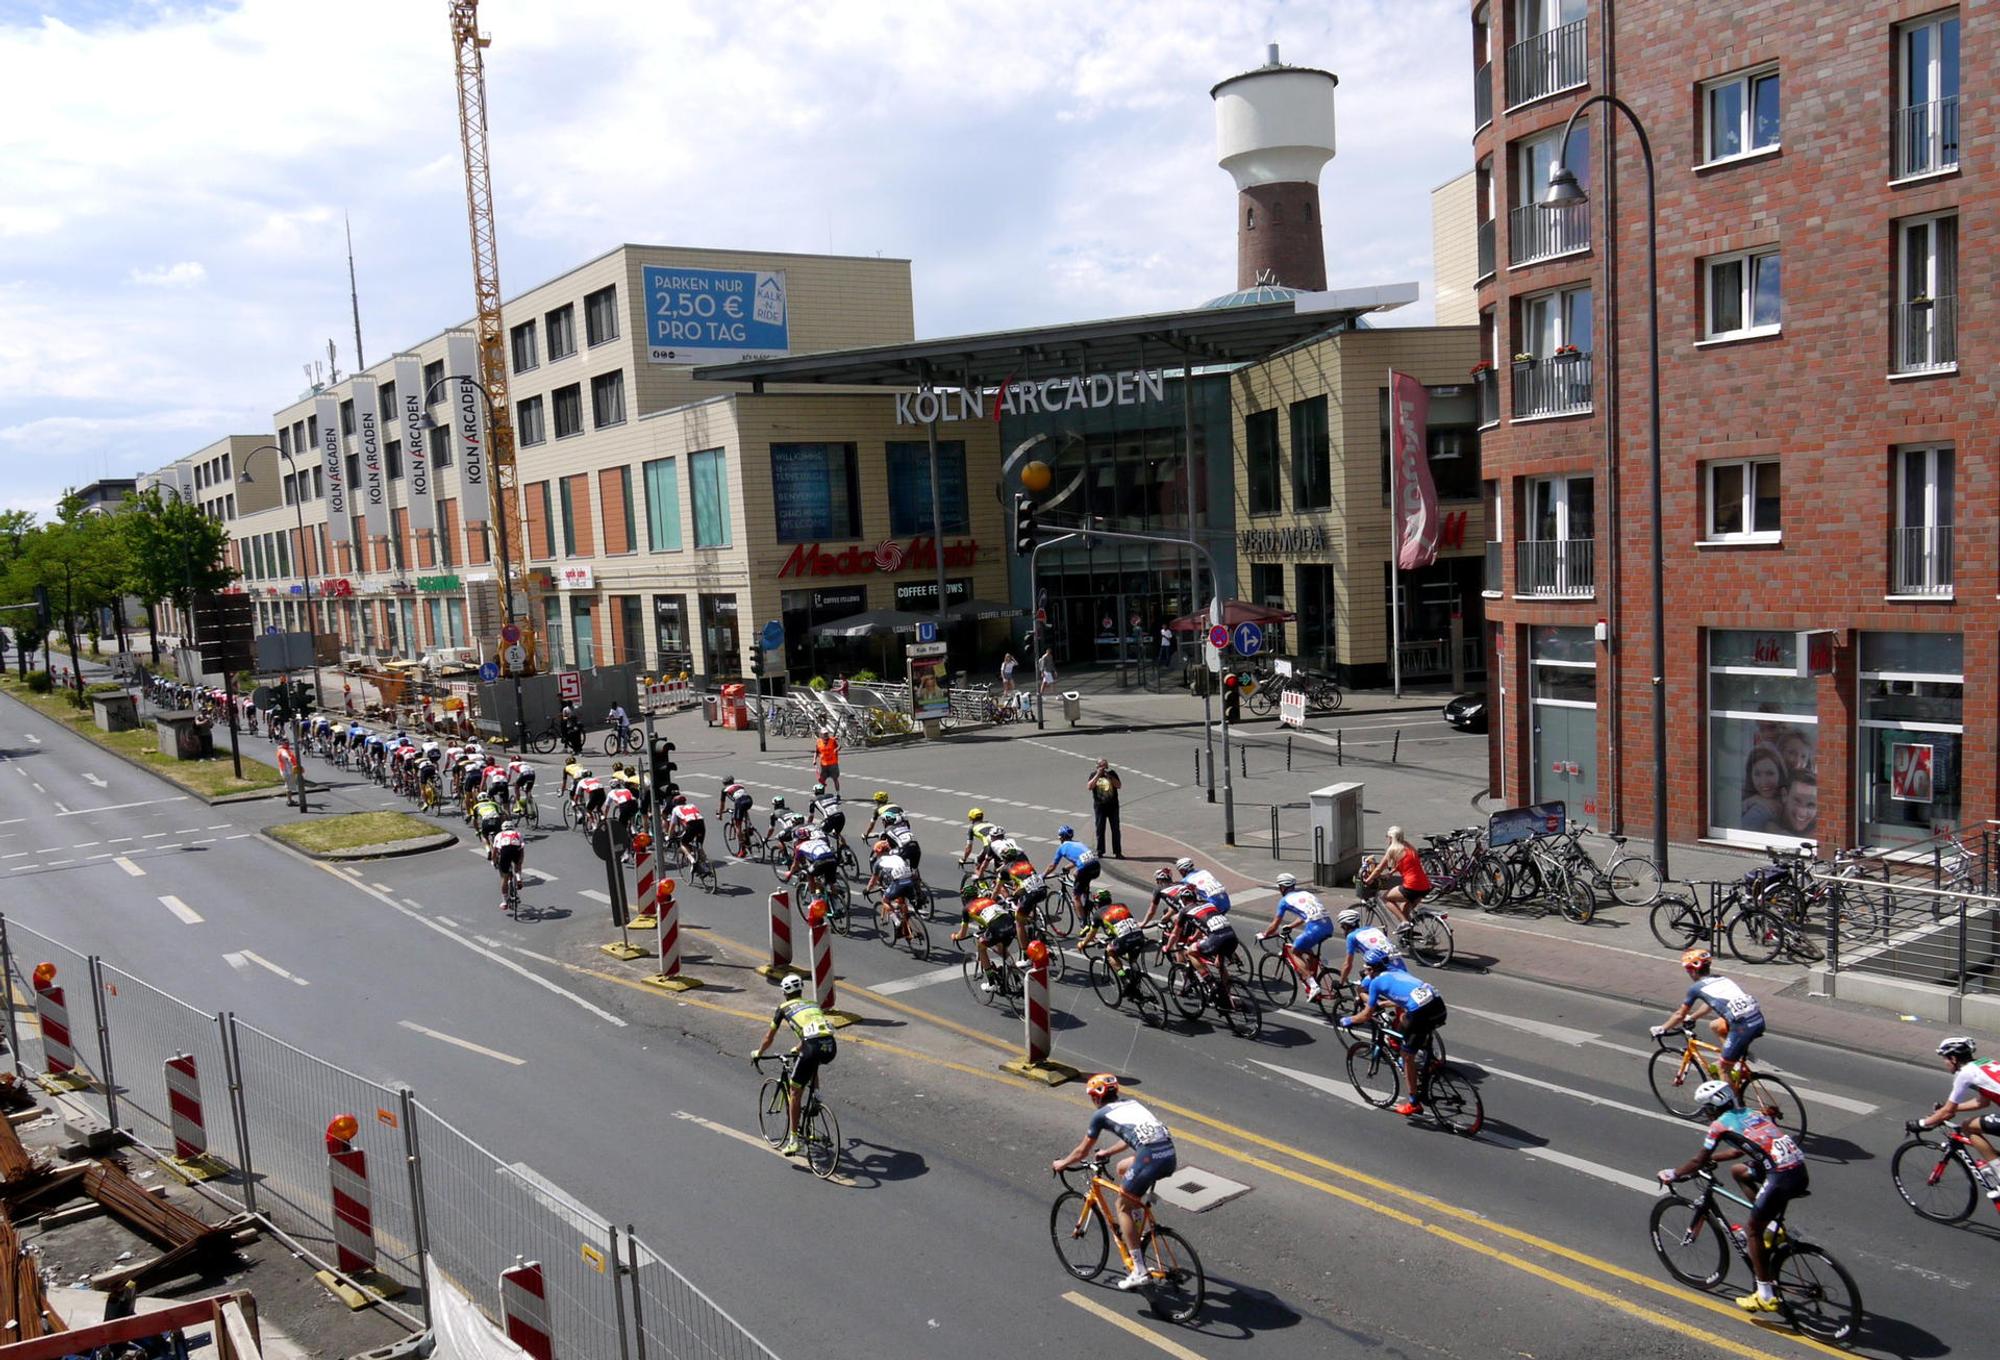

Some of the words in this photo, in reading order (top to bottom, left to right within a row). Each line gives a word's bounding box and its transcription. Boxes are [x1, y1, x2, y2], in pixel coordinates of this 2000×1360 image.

[655, 275, 709, 291] PARKEN
[715, 279, 743, 292] NUR
[656, 292, 716, 319] 2,50
[723, 295, 745, 319] €
[757, 308, 780, 321] RIDE
[658, 320, 702, 340] PRO
[706, 322, 746, 342] TAG
[460, 374, 480, 444] ARCADEN
[895, 381, 984, 425] KÖLN
[993, 367, 1164, 423] ARCADEN
[324, 427, 342, 482] ARCADEN
[362, 412, 380, 471] ARCADEN
[411, 460, 427, 496] KÖLN
[465, 446, 482, 485] KÖLN
[331, 483, 343, 513] KÖLN
[367, 472, 382, 505] KÖLN
[1242, 529, 1276, 551] VERO
[1280, 526, 1325, 551] MODA
[776, 542, 876, 579] Media
[902, 536, 979, 570] Markt
[897, 584, 928, 599] COFFEE
[928, 582, 964, 597] FEOWS
[921, 624, 933, 641] U
[1754, 637, 1781, 663] kik
